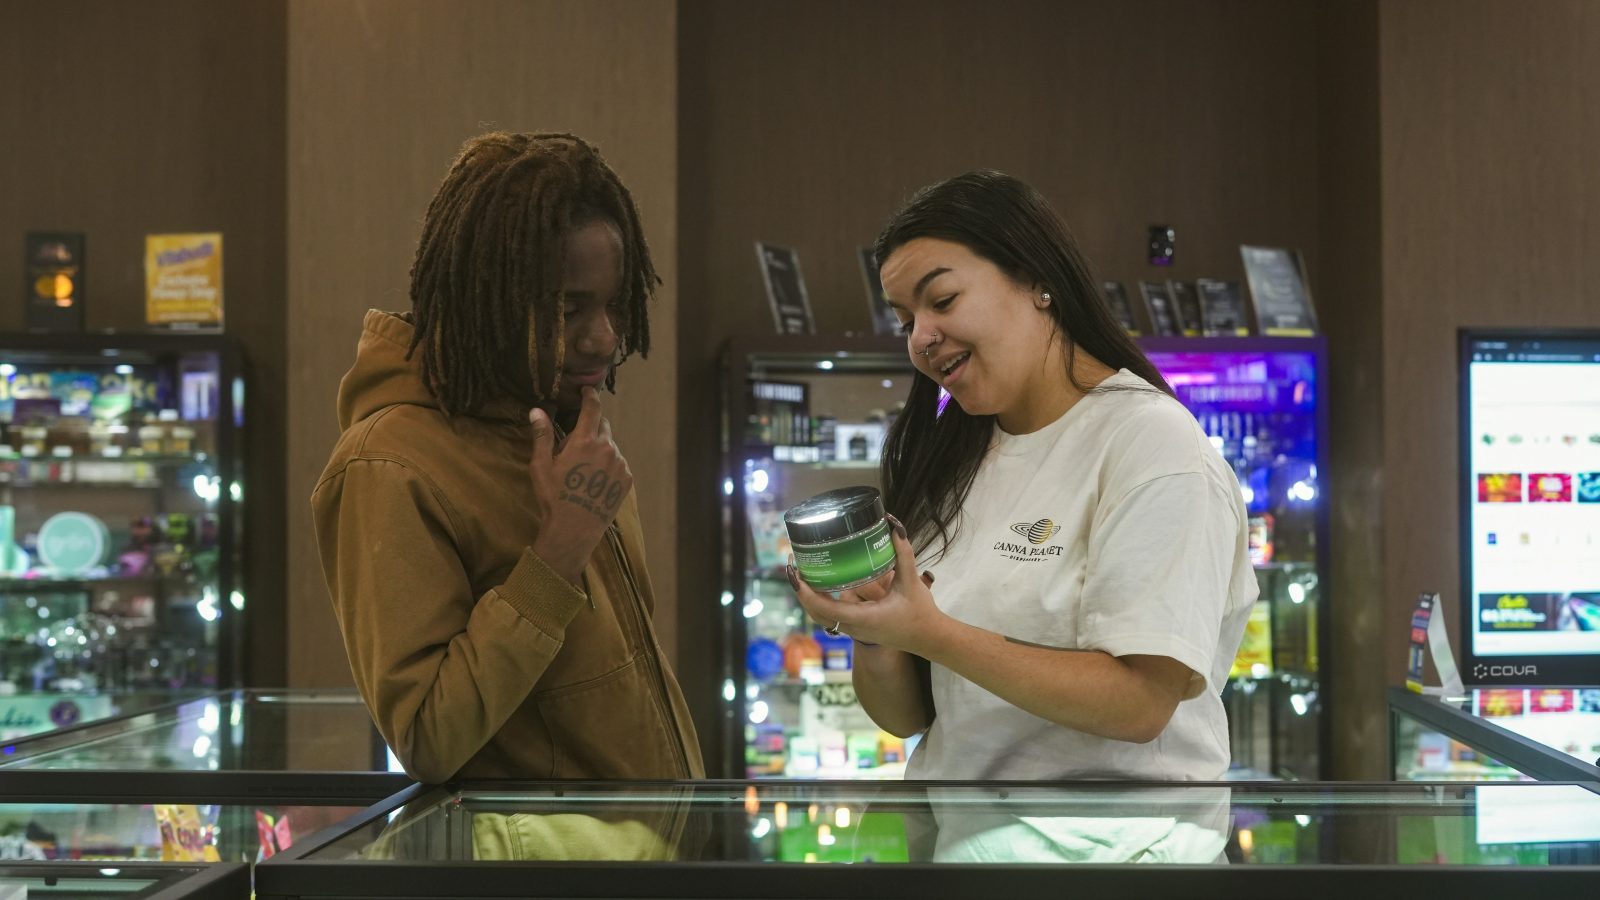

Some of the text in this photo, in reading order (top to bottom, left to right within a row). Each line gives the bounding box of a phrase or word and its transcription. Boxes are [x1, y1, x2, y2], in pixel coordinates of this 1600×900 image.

[564, 462, 623, 510] 600
[993, 541, 1027, 556] CANNA
[1490, 665, 1537, 676] COVA
